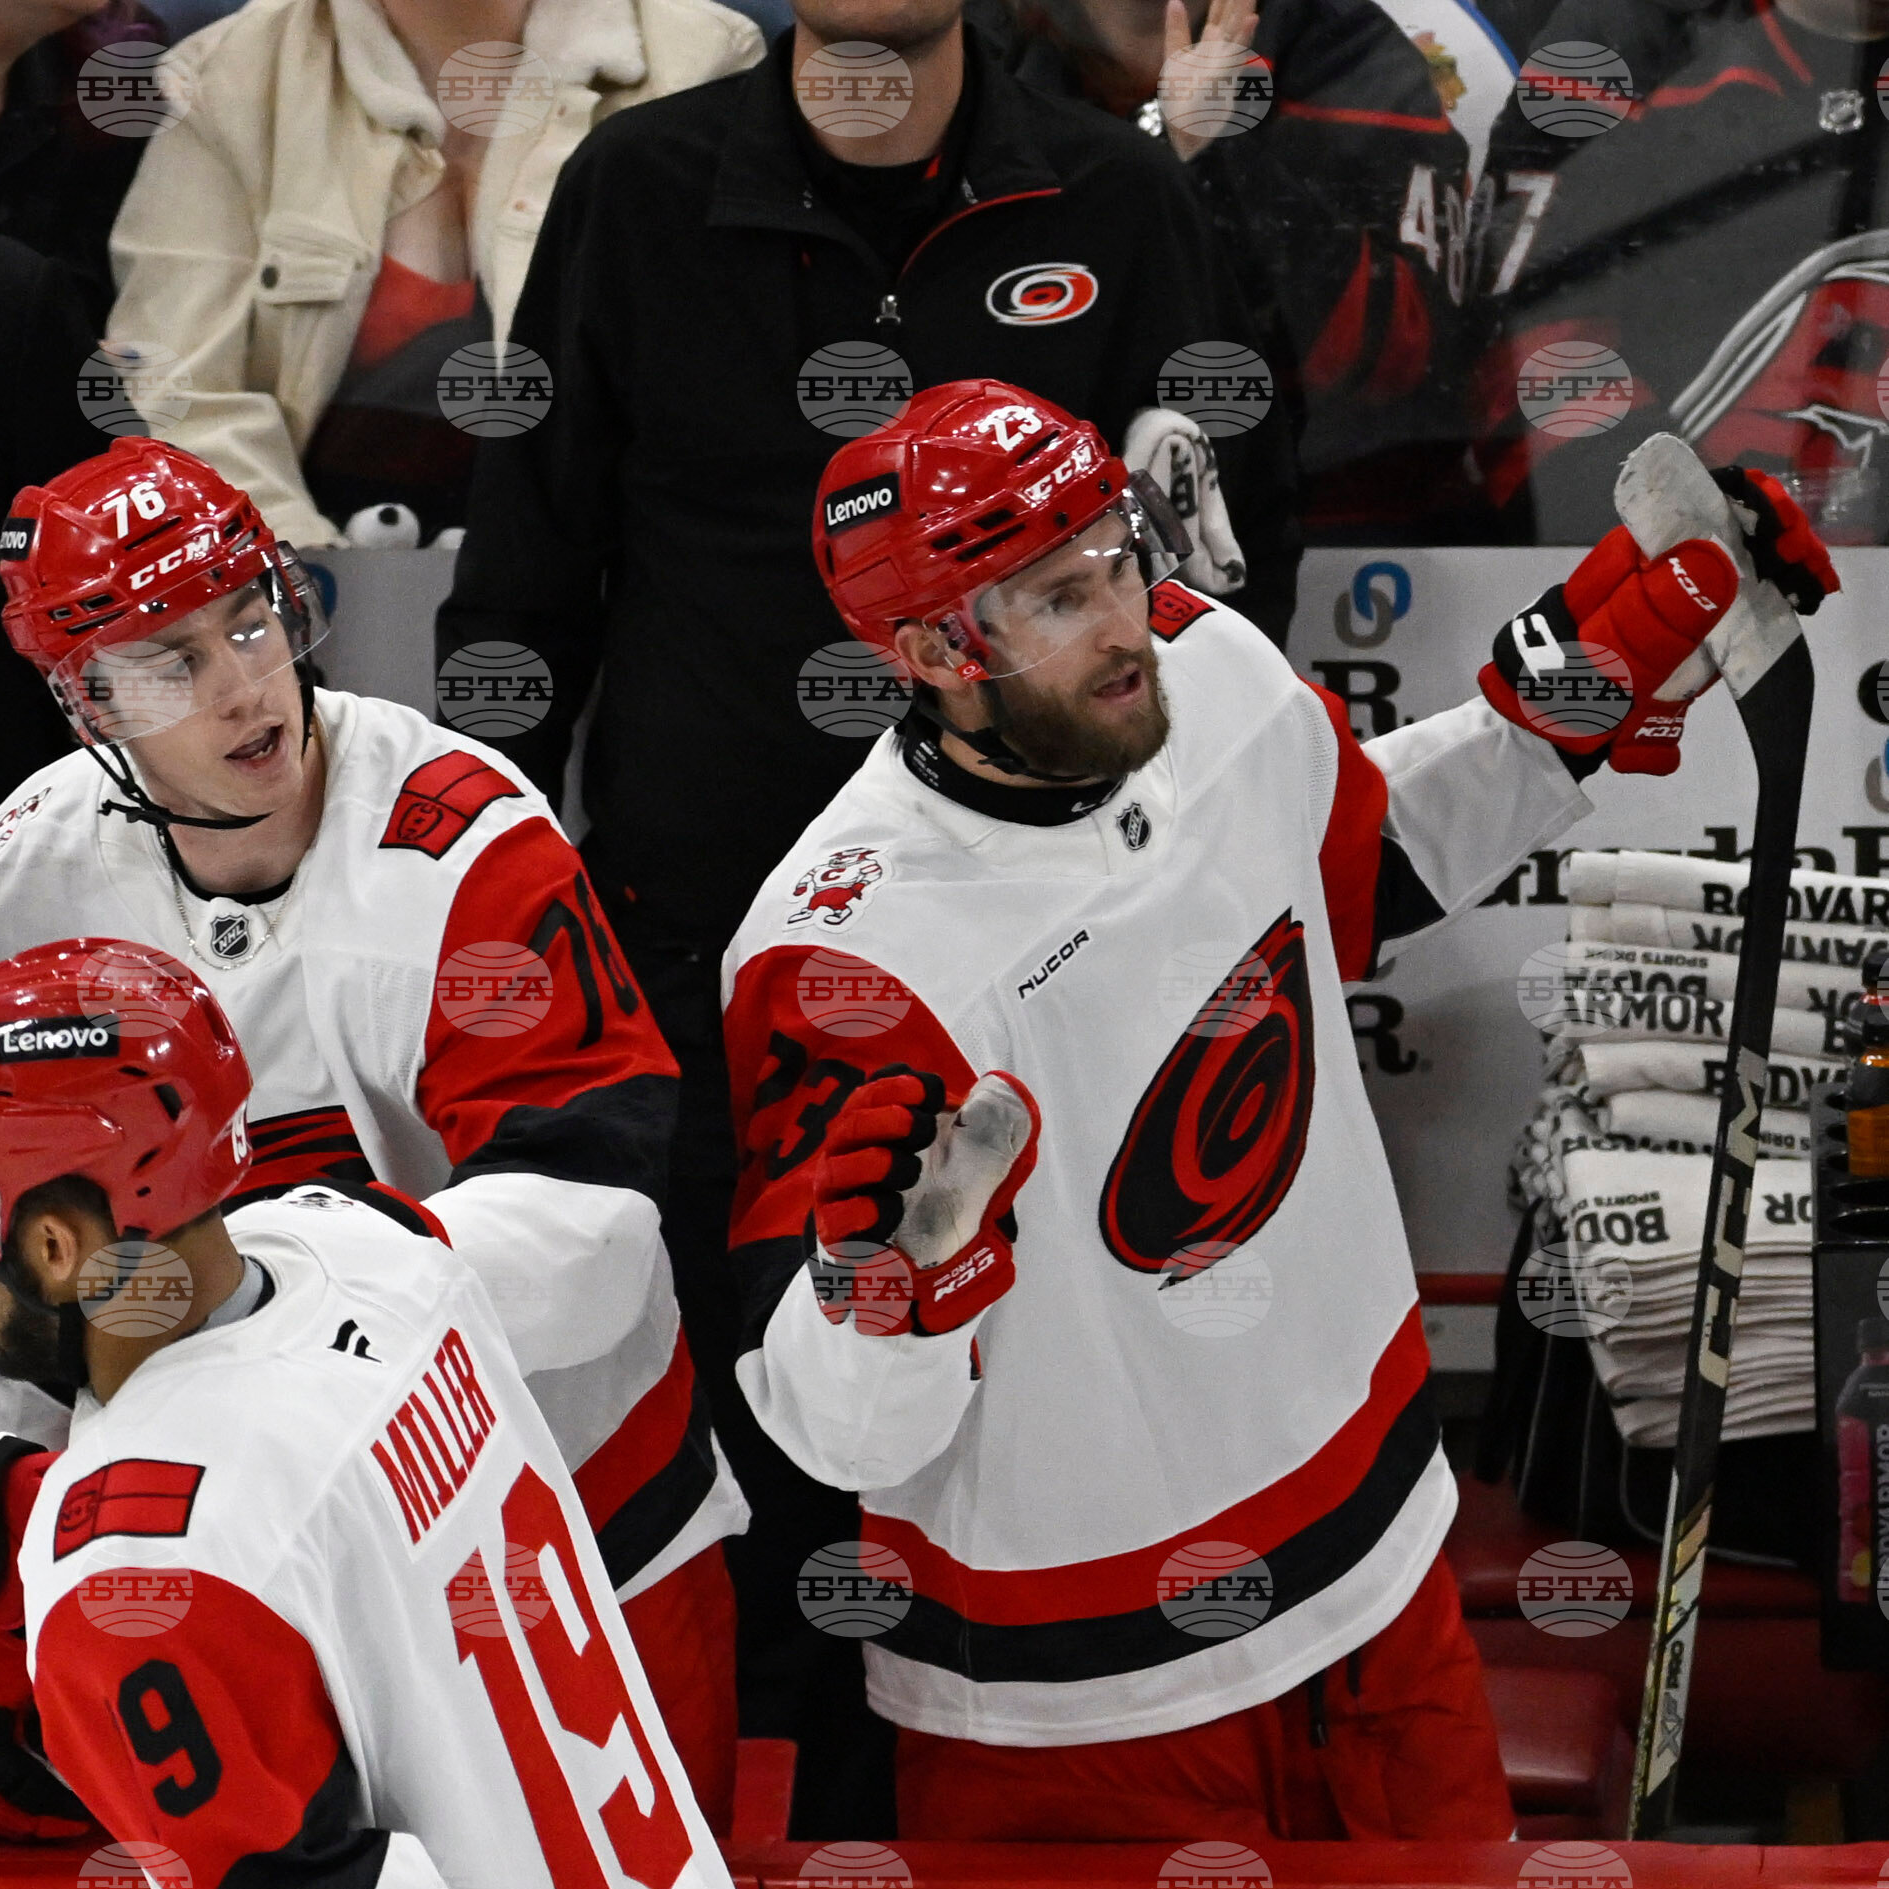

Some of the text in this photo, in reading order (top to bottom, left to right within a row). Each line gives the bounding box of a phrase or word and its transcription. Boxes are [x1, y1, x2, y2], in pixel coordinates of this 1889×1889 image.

[976, 405, 1043, 451] 23
[1023, 441, 1092, 502] CCM
[102, 481, 167, 539] 76
[826, 488, 892, 526] Lenovo
[130, 534, 211, 590] CCM
[1017, 929, 1090, 999] NUCOR
[2, 1026, 109, 1054] Lenovo
[934, 1252, 996, 1302] CCM
[370, 1326, 497, 1546] MILLER
[1668, 1639, 1685, 1690] PRO
